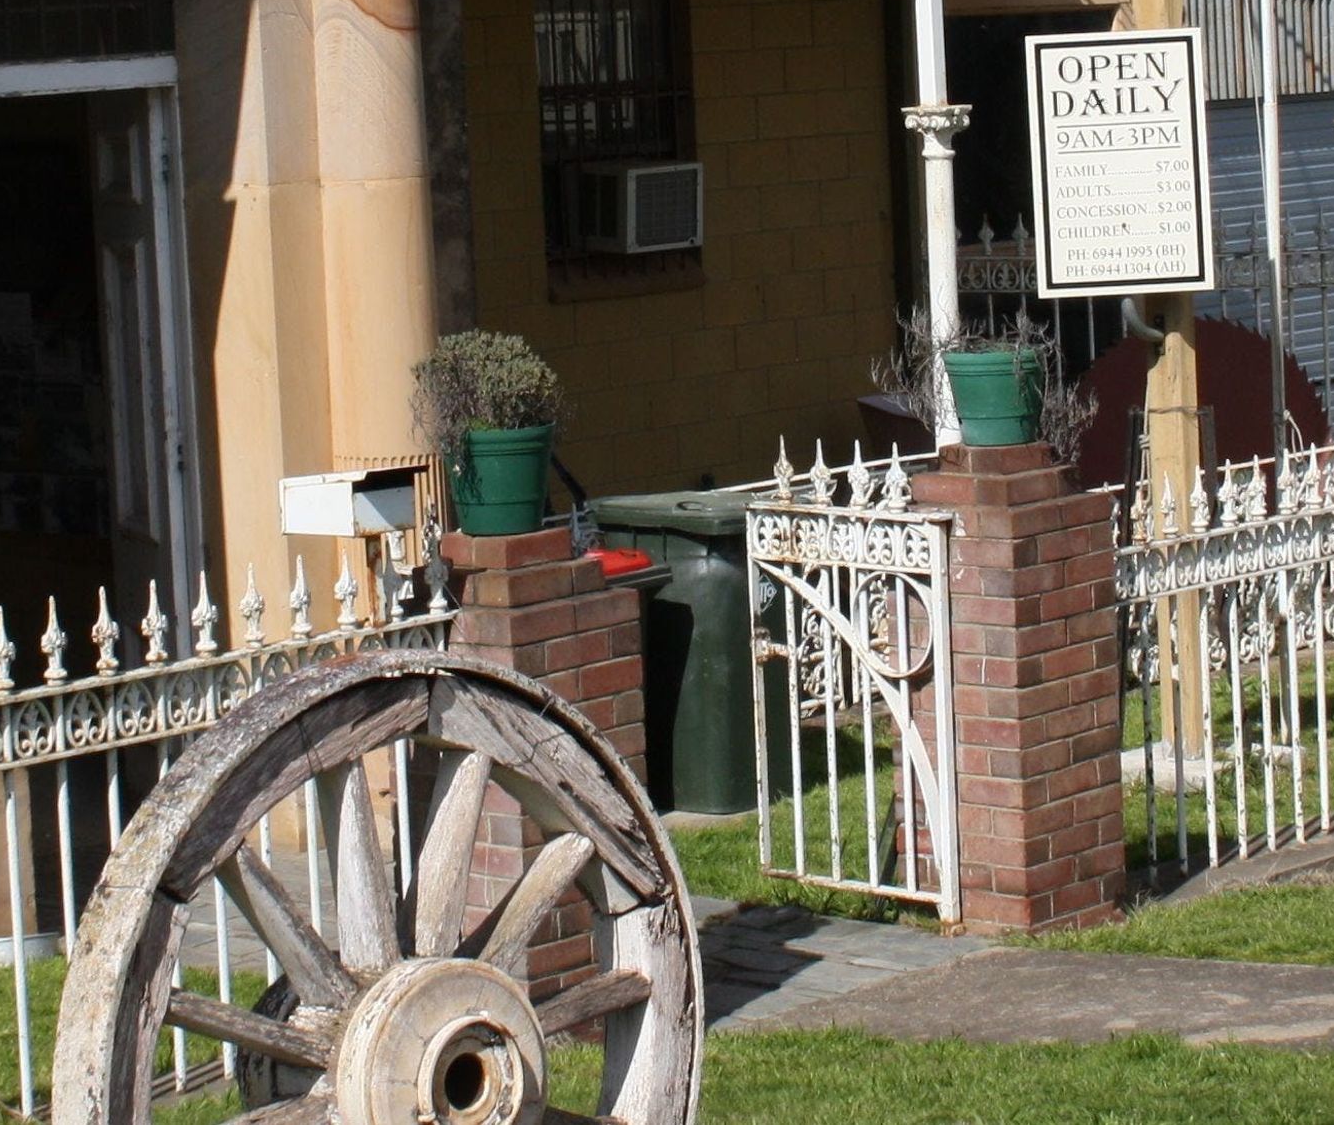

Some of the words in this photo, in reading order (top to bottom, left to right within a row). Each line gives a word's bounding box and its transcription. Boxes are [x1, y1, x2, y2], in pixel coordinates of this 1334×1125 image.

[1058, 51, 1168, 83] OPEN
[1051, 78, 1184, 118] DAILY
[1055, 164, 1108, 178] FAMILY
[1155, 160, 1189, 173] $7.00
[1056, 185, 1111, 198] ADULTS
[1156, 180, 1190, 193] $3.00
[1057, 203, 1147, 220] CONCESSION
[1157, 201, 1192, 214] $2.00
[1159, 221, 1191, 234] $1.00
[1154, 260, 1186, 275] (AH)
